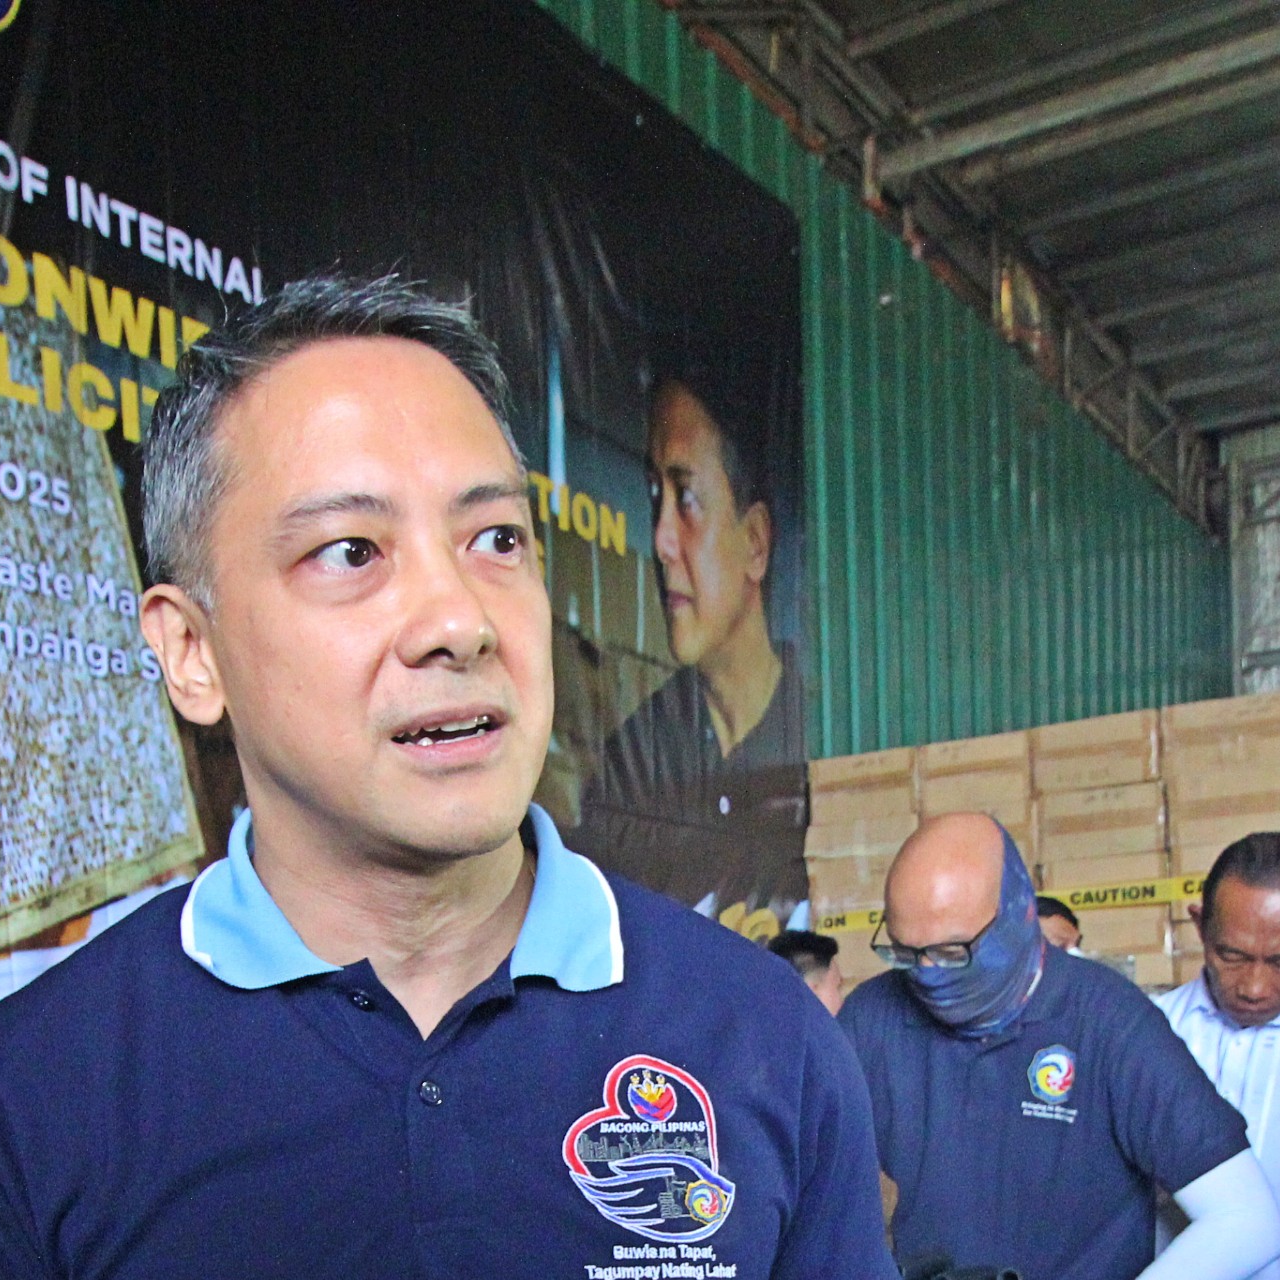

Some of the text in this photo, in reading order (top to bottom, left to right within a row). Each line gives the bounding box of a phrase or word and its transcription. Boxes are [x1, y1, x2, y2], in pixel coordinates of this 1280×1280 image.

[66, 176, 264, 304] INTERNAL
[528, 473, 627, 555] TION
[1071, 886, 1156, 905] CAUTION
[651, 1120, 706, 1133] PILIPINAS
[613, 1244, 658, 1260] Buwis
[678, 1244, 717, 1261] Tapat,
[662, 1263, 705, 1280] Nating
[705, 1263, 737, 1279] Lahat
